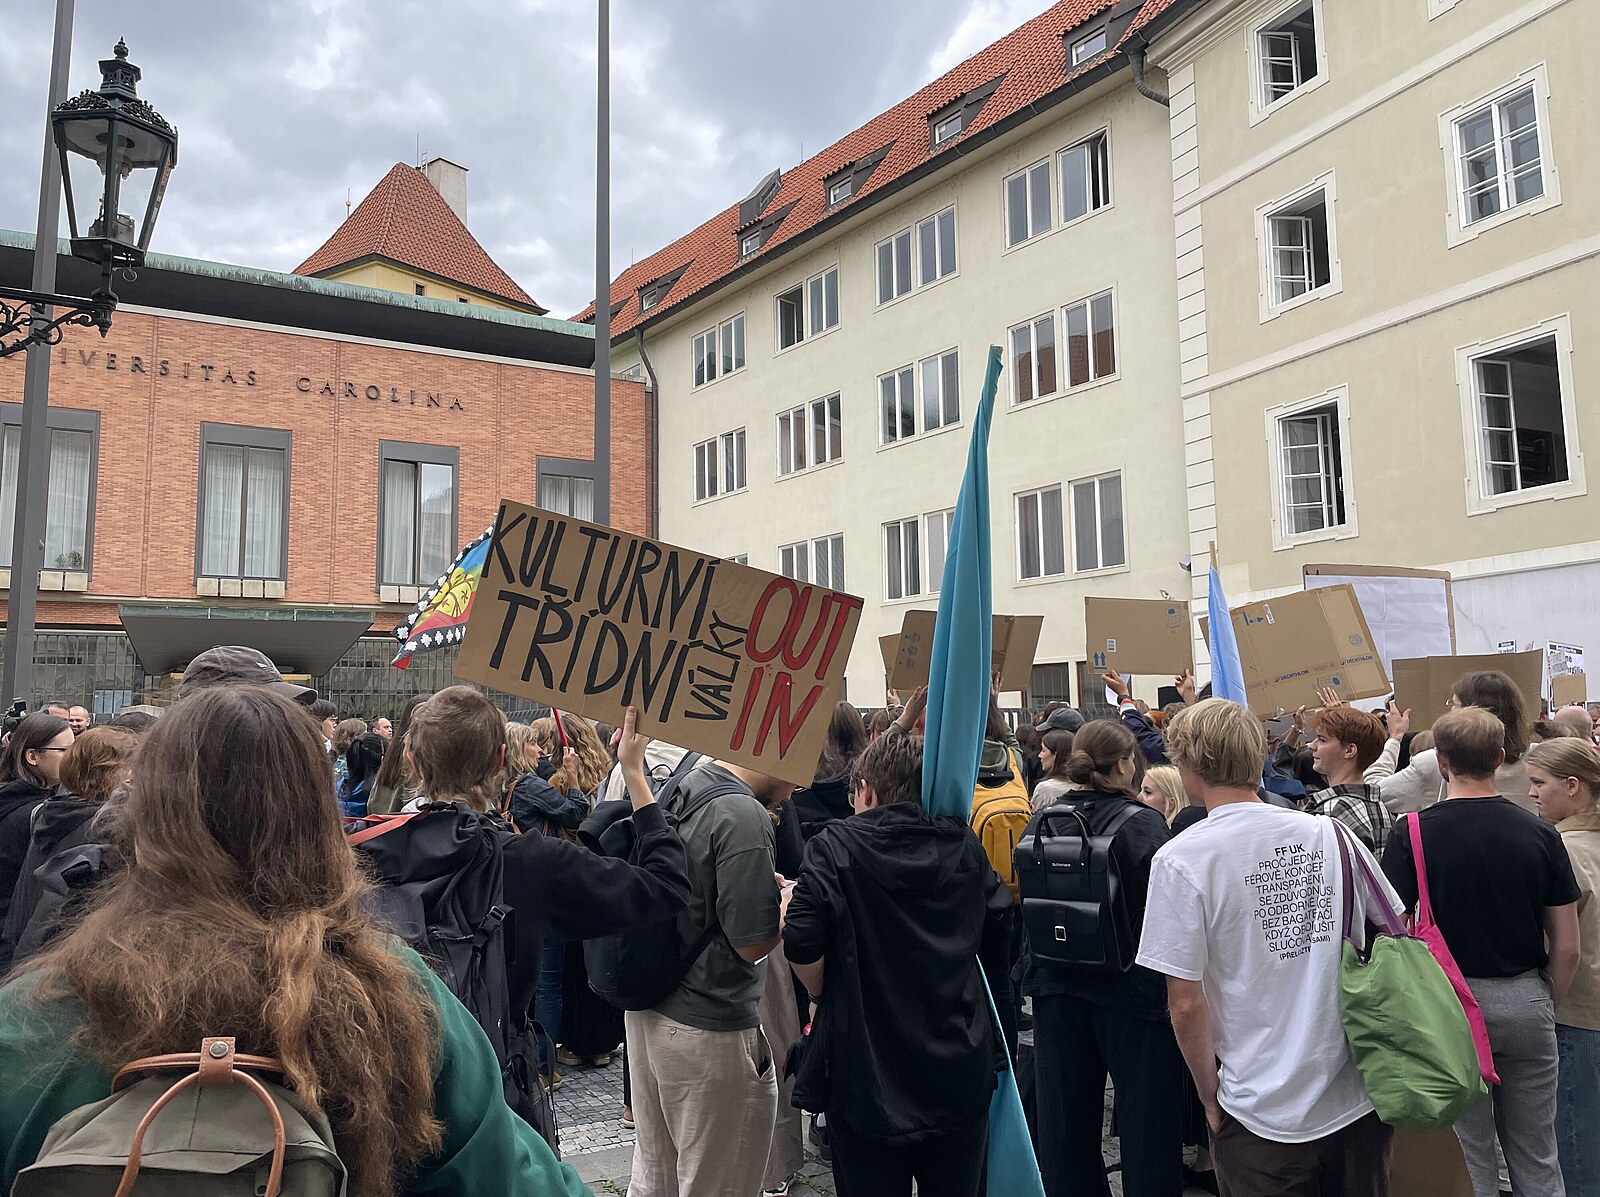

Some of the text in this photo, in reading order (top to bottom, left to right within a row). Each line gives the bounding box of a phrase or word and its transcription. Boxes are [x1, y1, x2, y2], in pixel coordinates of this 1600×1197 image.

[60, 347, 464, 410] IVERSITAS CAROLINA
[482, 504, 720, 640] KULTURNÍ
[745, 576, 863, 680] OUT
[489, 590, 705, 723] TŘÍDNÍ
[684, 610, 749, 721] VÁLKY
[730, 666, 823, 760] IN
[1258, 857, 1287, 871] PROČ
[1274, 843, 1305, 857] FF UK
[1254, 908, 1267, 920] PO
[1259, 896, 1272, 906] SE
[1262, 917, 1281, 930] BEZ
[1265, 926, 1291, 941] KDYŽ
